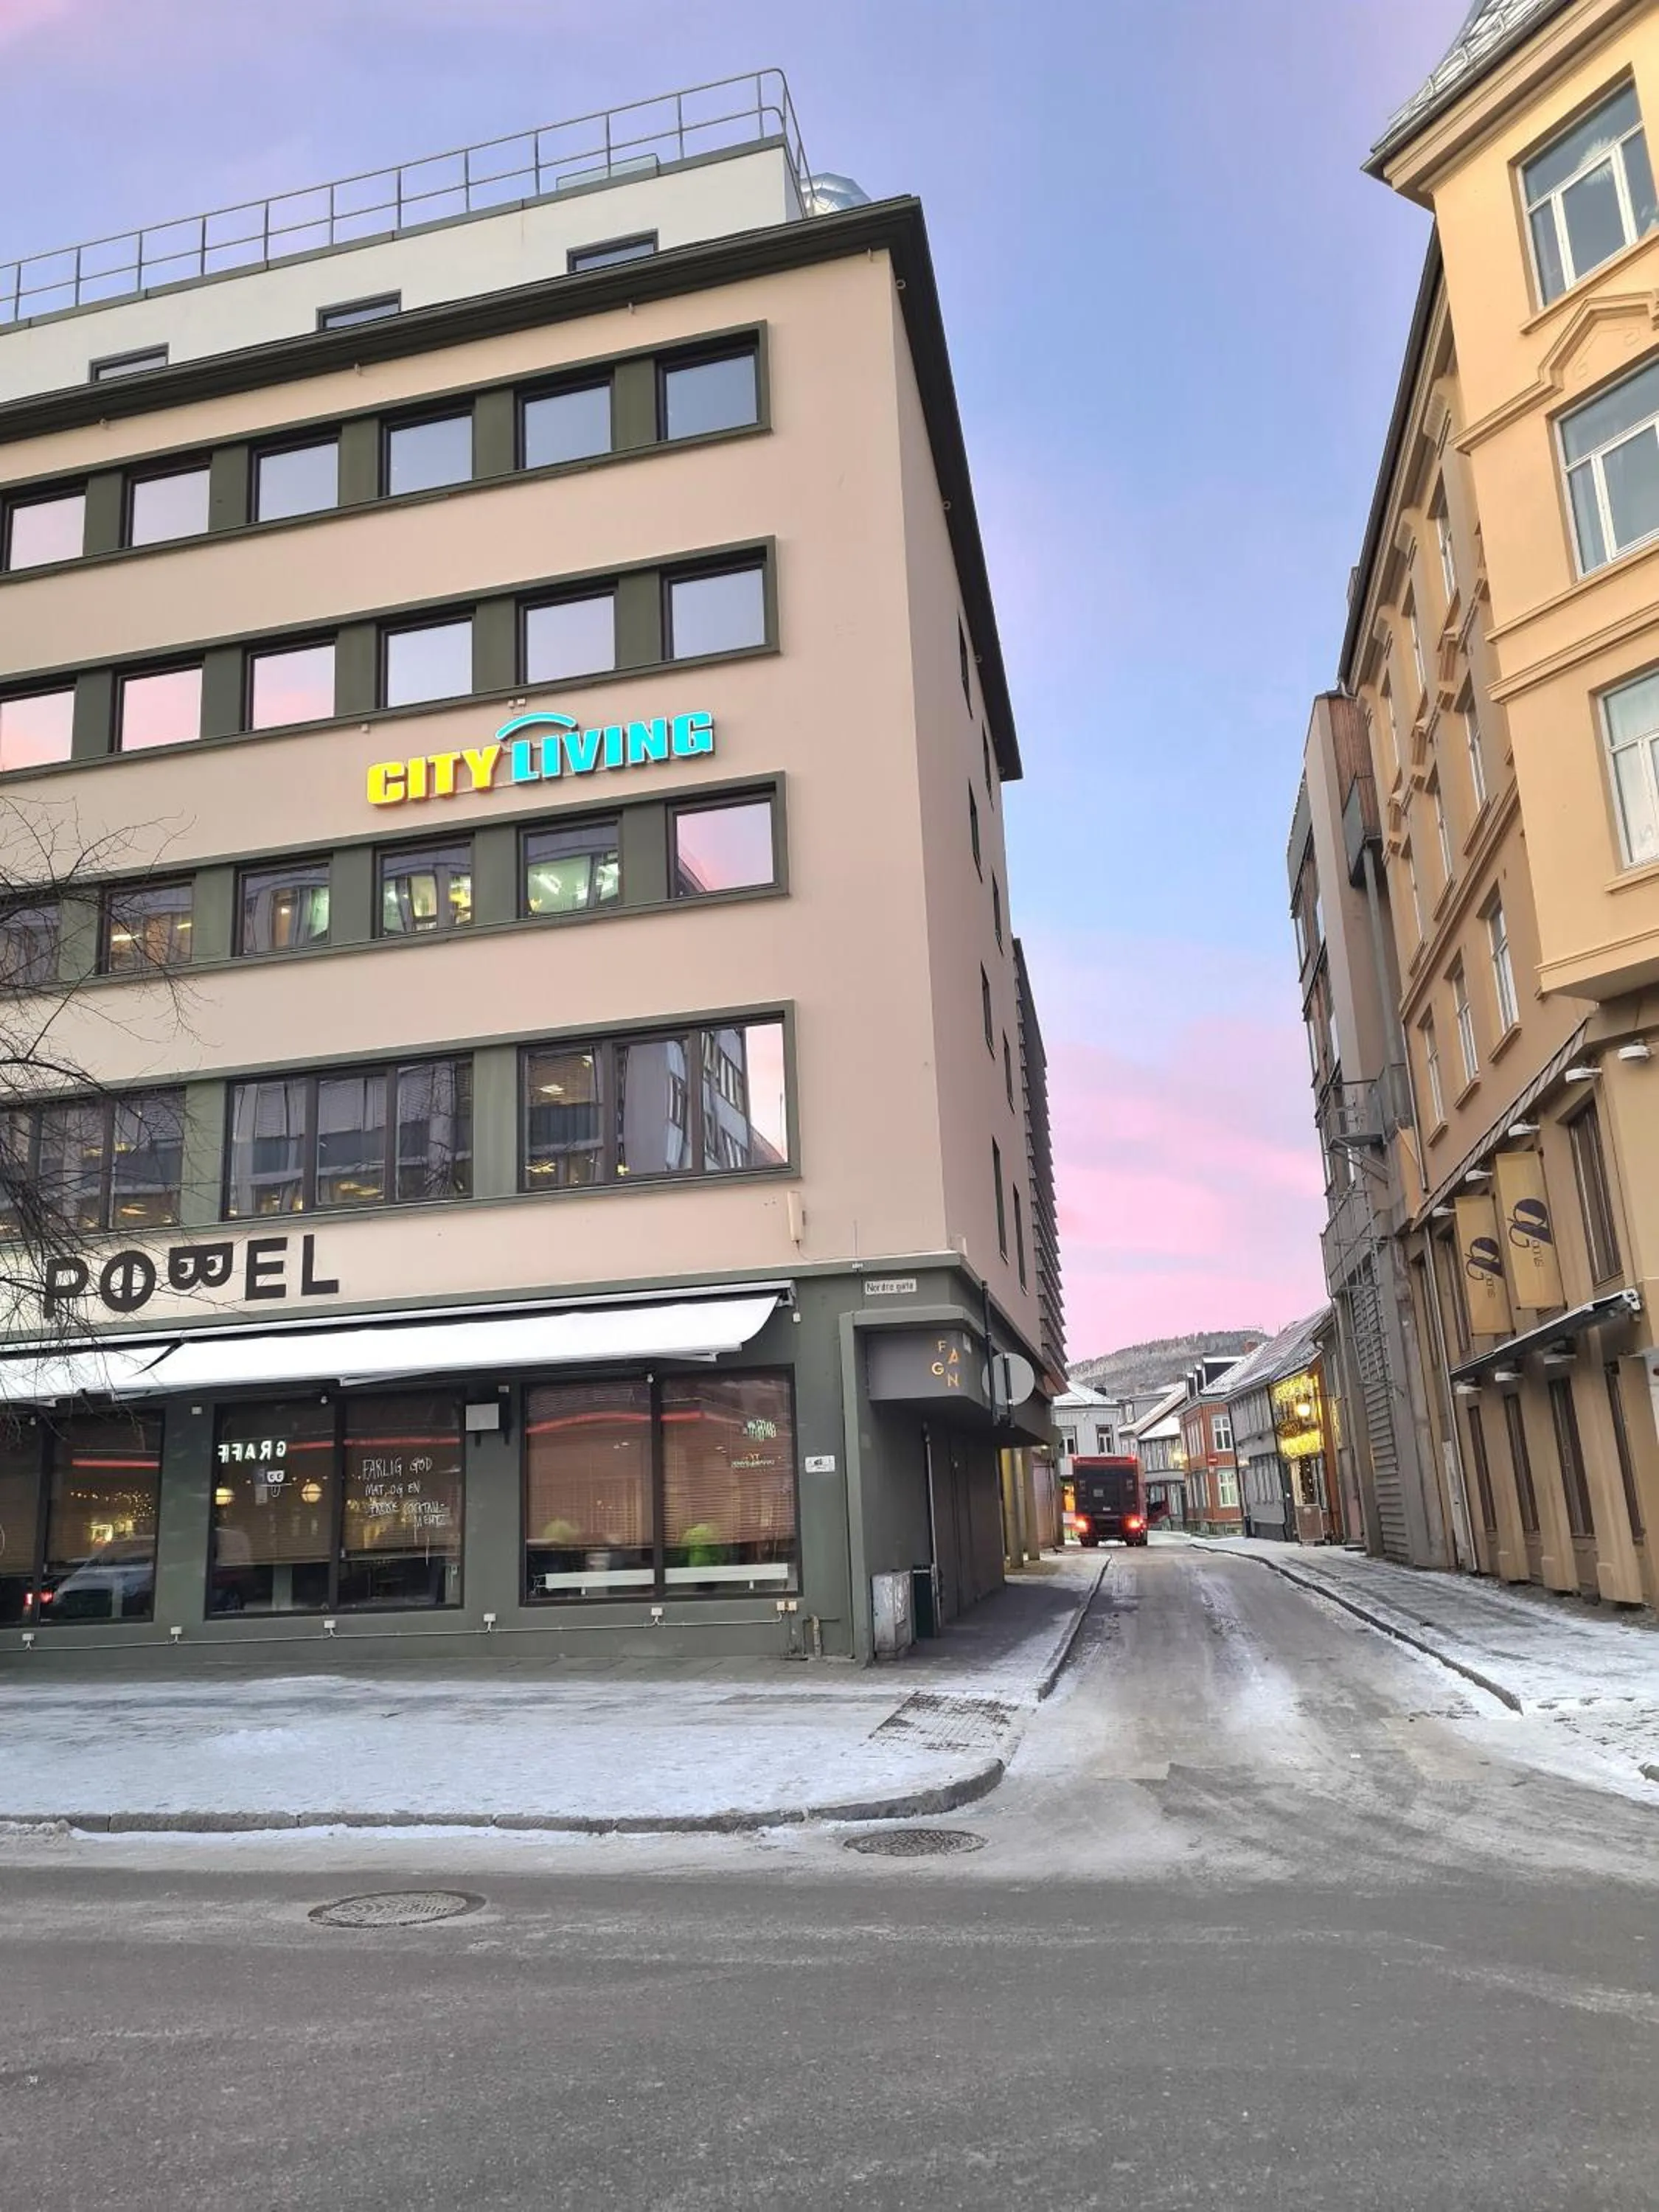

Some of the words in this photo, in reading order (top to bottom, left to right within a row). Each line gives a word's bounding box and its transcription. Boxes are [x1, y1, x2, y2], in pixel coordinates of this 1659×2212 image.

[368, 744, 502, 805] CITY
[511, 711, 714, 784] LIVING
[866, 1282, 894, 1293] Nordre
[896, 1282, 914, 1293] gate
[363, 1457, 402, 1479] FARLIG
[409, 1457, 433, 1474] GOD
